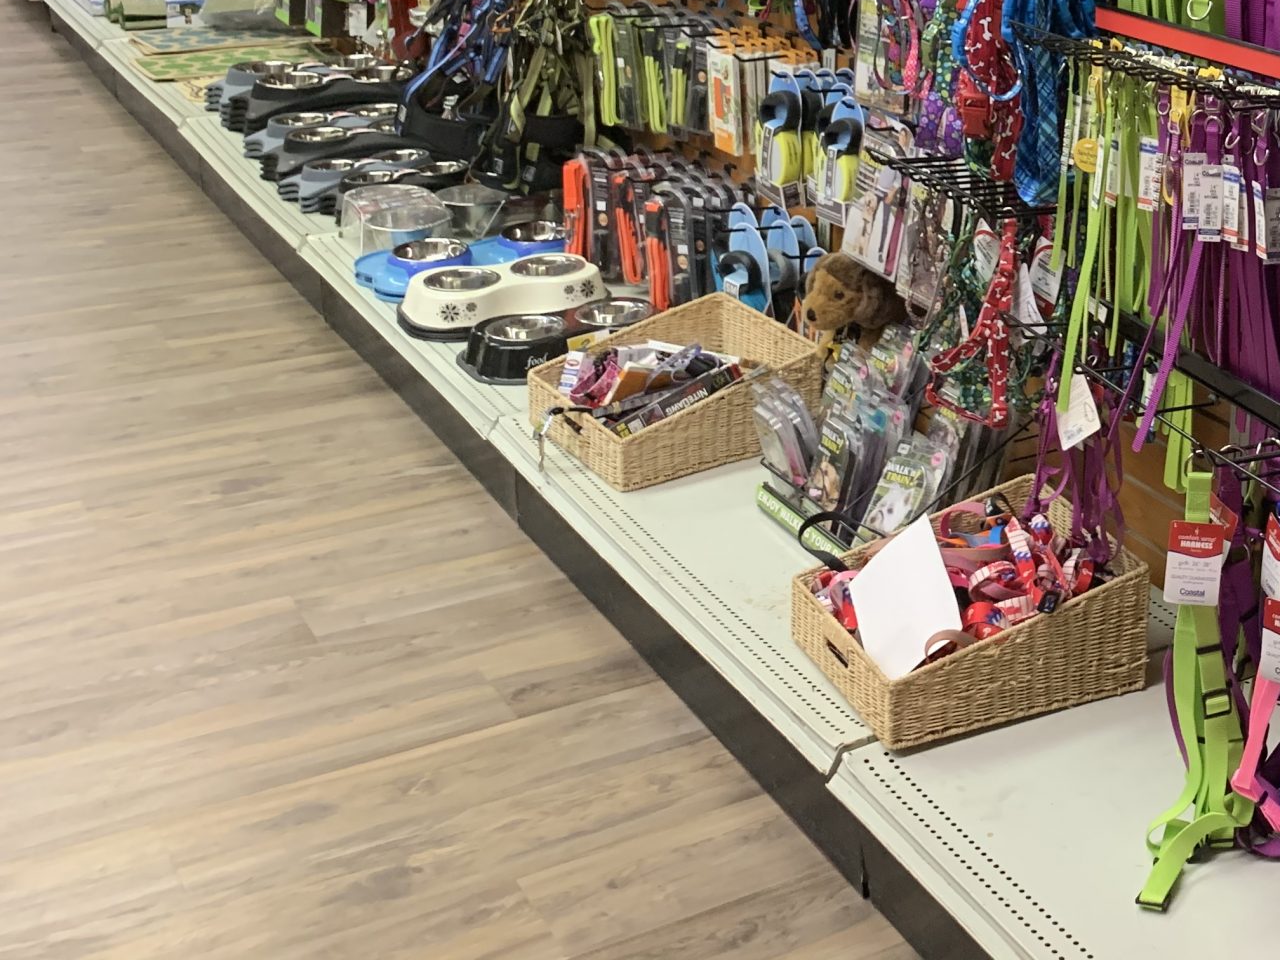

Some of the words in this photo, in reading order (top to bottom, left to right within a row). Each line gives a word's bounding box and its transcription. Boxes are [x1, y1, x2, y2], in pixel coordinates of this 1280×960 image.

[525, 352, 549, 370] food
[757, 491, 780, 516] ENJOY
[810, 531, 833, 556] YOUR
[1180, 540, 1213, 549] HARNESS
[1179, 588, 1205, 597] Coastal
